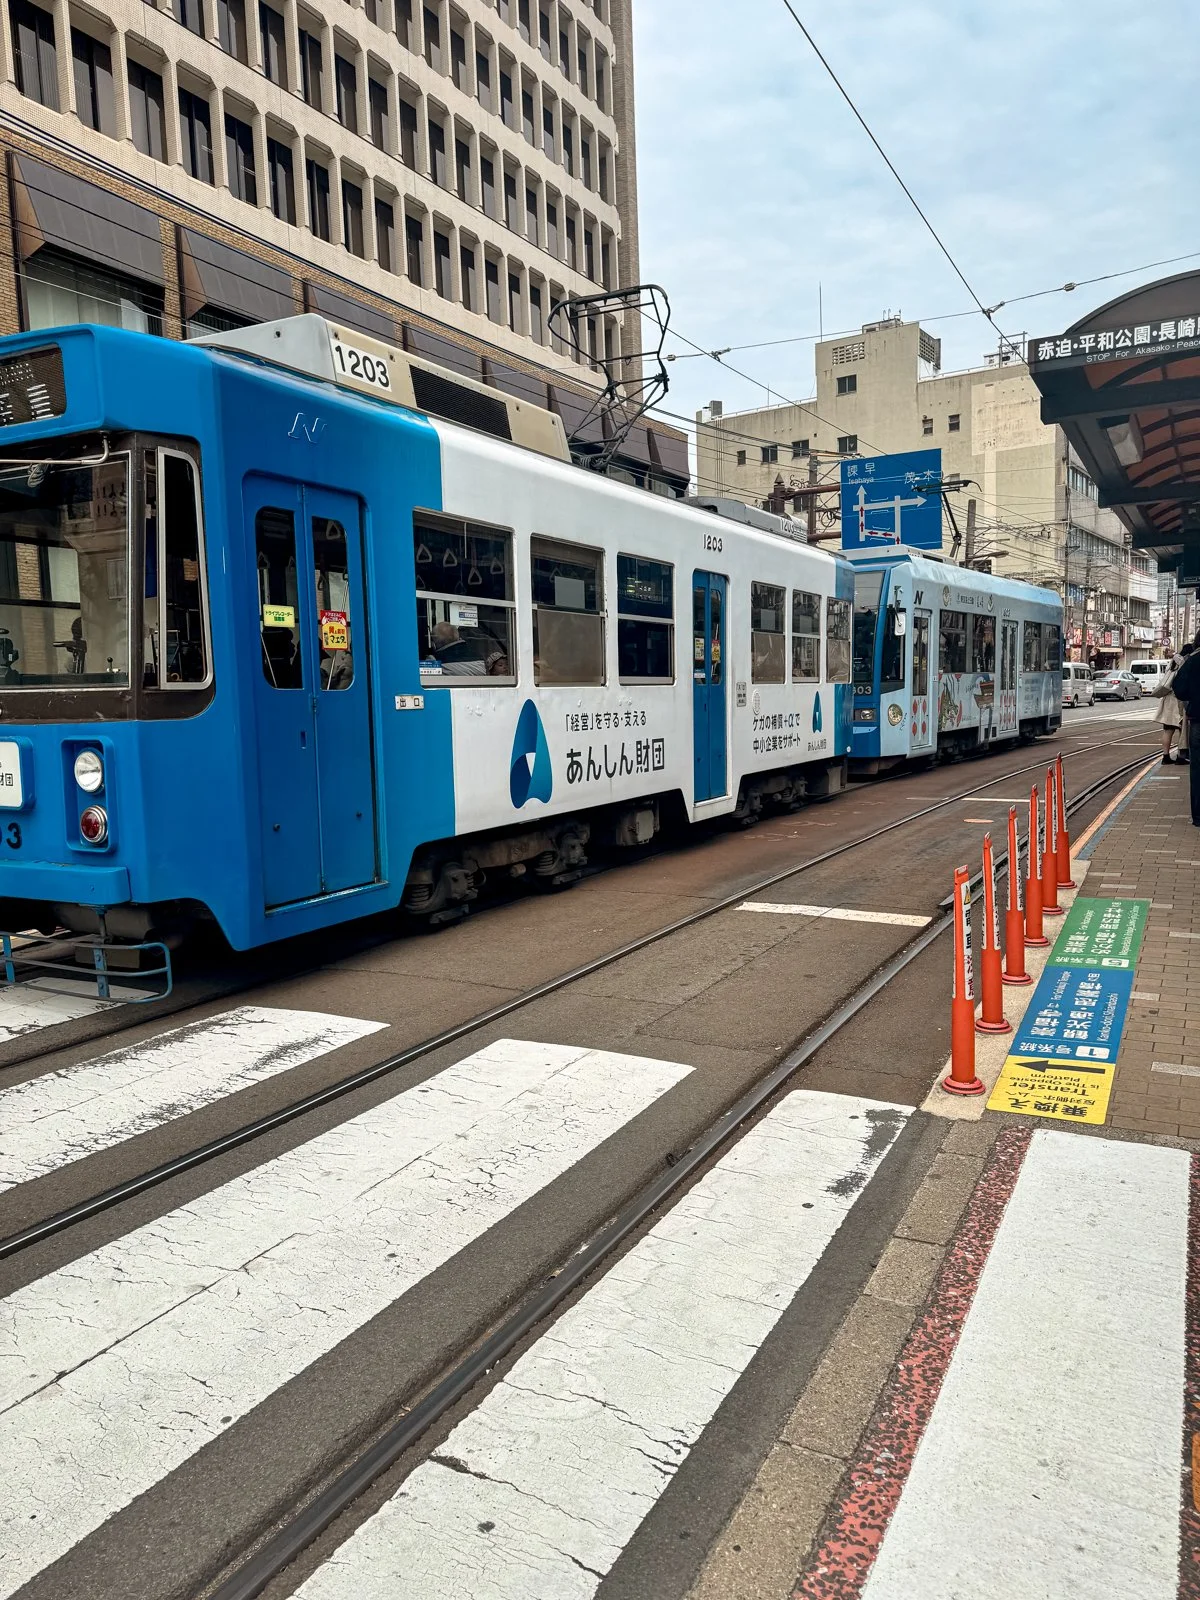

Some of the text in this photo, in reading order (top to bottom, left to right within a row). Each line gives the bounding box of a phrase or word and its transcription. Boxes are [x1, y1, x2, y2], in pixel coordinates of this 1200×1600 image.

[1038, 316, 1200, 360] 赤迫・平和公園・長崎
[1086, 352, 1111, 363] STOP
[1115, 350, 1130, 358] For
[1135, 344, 1171, 355] Akasako
[334, 345, 390, 388] 1203
[904, 469, 935, 485] 茂木
[703, 533, 723, 552] 1203
[913, 590, 923, 605] N
[400, 697, 420, 707] 出口
[566, 711, 647, 732] 「経営」を守る・支える
[753, 733, 801, 754] 中小企業をサポート
[566, 738, 665, 784] あんしん財団
[1019, 1042, 1072, 1055] 号系統
[1010, 1077, 1061, 1085] Opposite
[1030, 1074, 1081, 1082] Platform
[1009, 1081, 1089, 1096] Transfer
[1006, 1091, 1095, 1105] 反対側ホームへ
[1008, 1098, 1087, 1117] 乗換え
